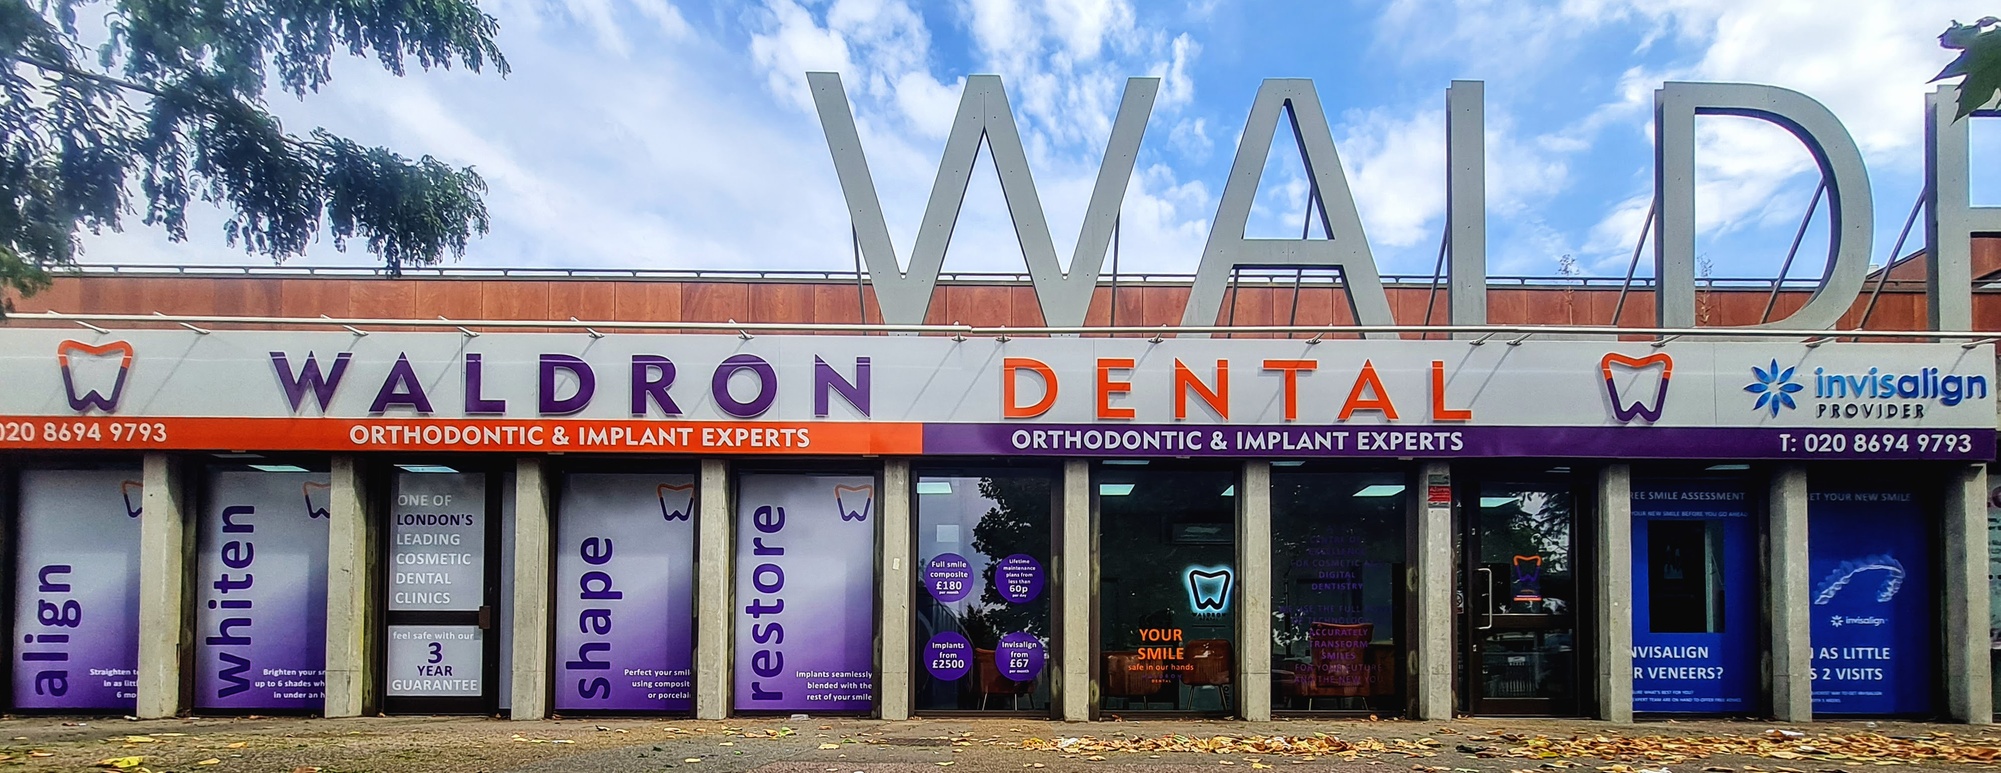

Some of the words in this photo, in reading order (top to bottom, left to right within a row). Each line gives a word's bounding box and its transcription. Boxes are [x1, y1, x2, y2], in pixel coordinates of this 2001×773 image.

[269, 350, 871, 419] WALDRON
[1003, 357, 1473, 421] DENTAL
[1815, 366, 1987, 406] invisalign
[1816, 403, 1925, 419] PROVIDER
[43, 422, 101, 442] 8694
[109, 423, 167, 443] 9793
[349, 425, 542, 446] ORTHODONTIC
[551, 426, 570, 446] &
[578, 426, 693, 447] IMPLANT
[702, 427, 810, 448] EXPERTS
[1011, 429, 1202, 451] ORTHODONTIC
[1209, 430, 1228, 451] &
[1236, 430, 1349, 451] IMPLANT
[1357, 431, 1464, 452] EXPERTS
[1779, 434, 1796, 453] T:
[1804, 434, 1847, 453] 020
[1854, 434, 1909, 453] 8694
[1917, 434, 1972, 453] 9793
[397, 494, 428, 506] ONE
[432, 494, 453, 506] OF
[1648, 491, 1678, 500] SMILE
[1680, 491, 1746, 501] ASSESSMENT
[1824, 493, 1852, 501] YOUR
[1854, 493, 1879, 501] NEW
[1880, 493, 1911, 501] SMILE
[397, 514, 474, 526] LONDON'S
[396, 533, 461, 546] LEADING
[396, 553, 472, 565] COSMETIC
[395, 572, 452, 585] DENTAL
[930, 571, 969, 579] composite
[1319, 571, 1356, 579] DIGITAL
[936, 581, 962, 590] £180
[1009, 585, 1028, 594] 60p
[1312, 583, 1364, 591] DENTISTRY
[205, 505, 256, 699] whiten
[395, 592, 451, 604] CLINICS
[745, 504, 786, 701] restore
[1318, 605, 1335, 613] THE
[1339, 605, 1361, 613] FULL
[565, 536, 624, 700] shape
[1845, 616, 1885, 626] invisalign
[22, 564, 82, 697] align
[393, 631, 411, 640] feel
[413, 631, 432, 640] safe
[434, 631, 455, 640] with
[1139, 628, 1183, 642] YOUR
[1309, 628, 1369, 636] ACCURATELY
[932, 642, 965, 650] Implants
[1002, 641, 1037, 650] Invisalign
[1309, 640, 1369, 648] TRANSFORM
[427, 641, 443, 664] 3
[939, 651, 957, 659] from
[1010, 650, 1029, 658] from
[1137, 647, 1185, 660] SMILE
[1321, 652, 1357, 660] SMILES
[1819, 647, 1838, 659] AS
[1843, 647, 1890, 660] LITTLE
[932, 659, 965, 668] £2500
[1010, 659, 1029, 668] £67
[1128, 663, 1144, 671] safe
[1146, 663, 1154, 671] in
[1171, 663, 1194, 671] hands
[1294, 664, 1314, 672] FOR
[1347, 664, 1382, 672] FUTURE
[89, 668, 131, 677] Straighten
[263, 668, 297, 677] Brighten
[298, 669, 316, 677] your
[417, 665, 453, 677] YEAR
[624, 668, 652, 677] Perfect
[654, 670, 673, 678] your
[796, 671, 830, 680] Implants
[831, 671, 873, 680] seamlessly
[1647, 667, 1724, 680] VENEERS?
[1822, 668, 1831, 680] 2
[1835, 668, 1883, 680] VISITS
[392, 679, 478, 691] GUARANTEE
[632, 680, 653, 688] using
[655, 680, 691, 688] composit
[1318, 676, 1335, 684] THE
[1338, 676, 1362, 684] NEW
[807, 682, 839, 690] blended
[840, 682, 858, 690] with
[859, 682, 873, 690] the
[658, 691, 691, 700] porcelai
[833, 694, 851, 702] your
